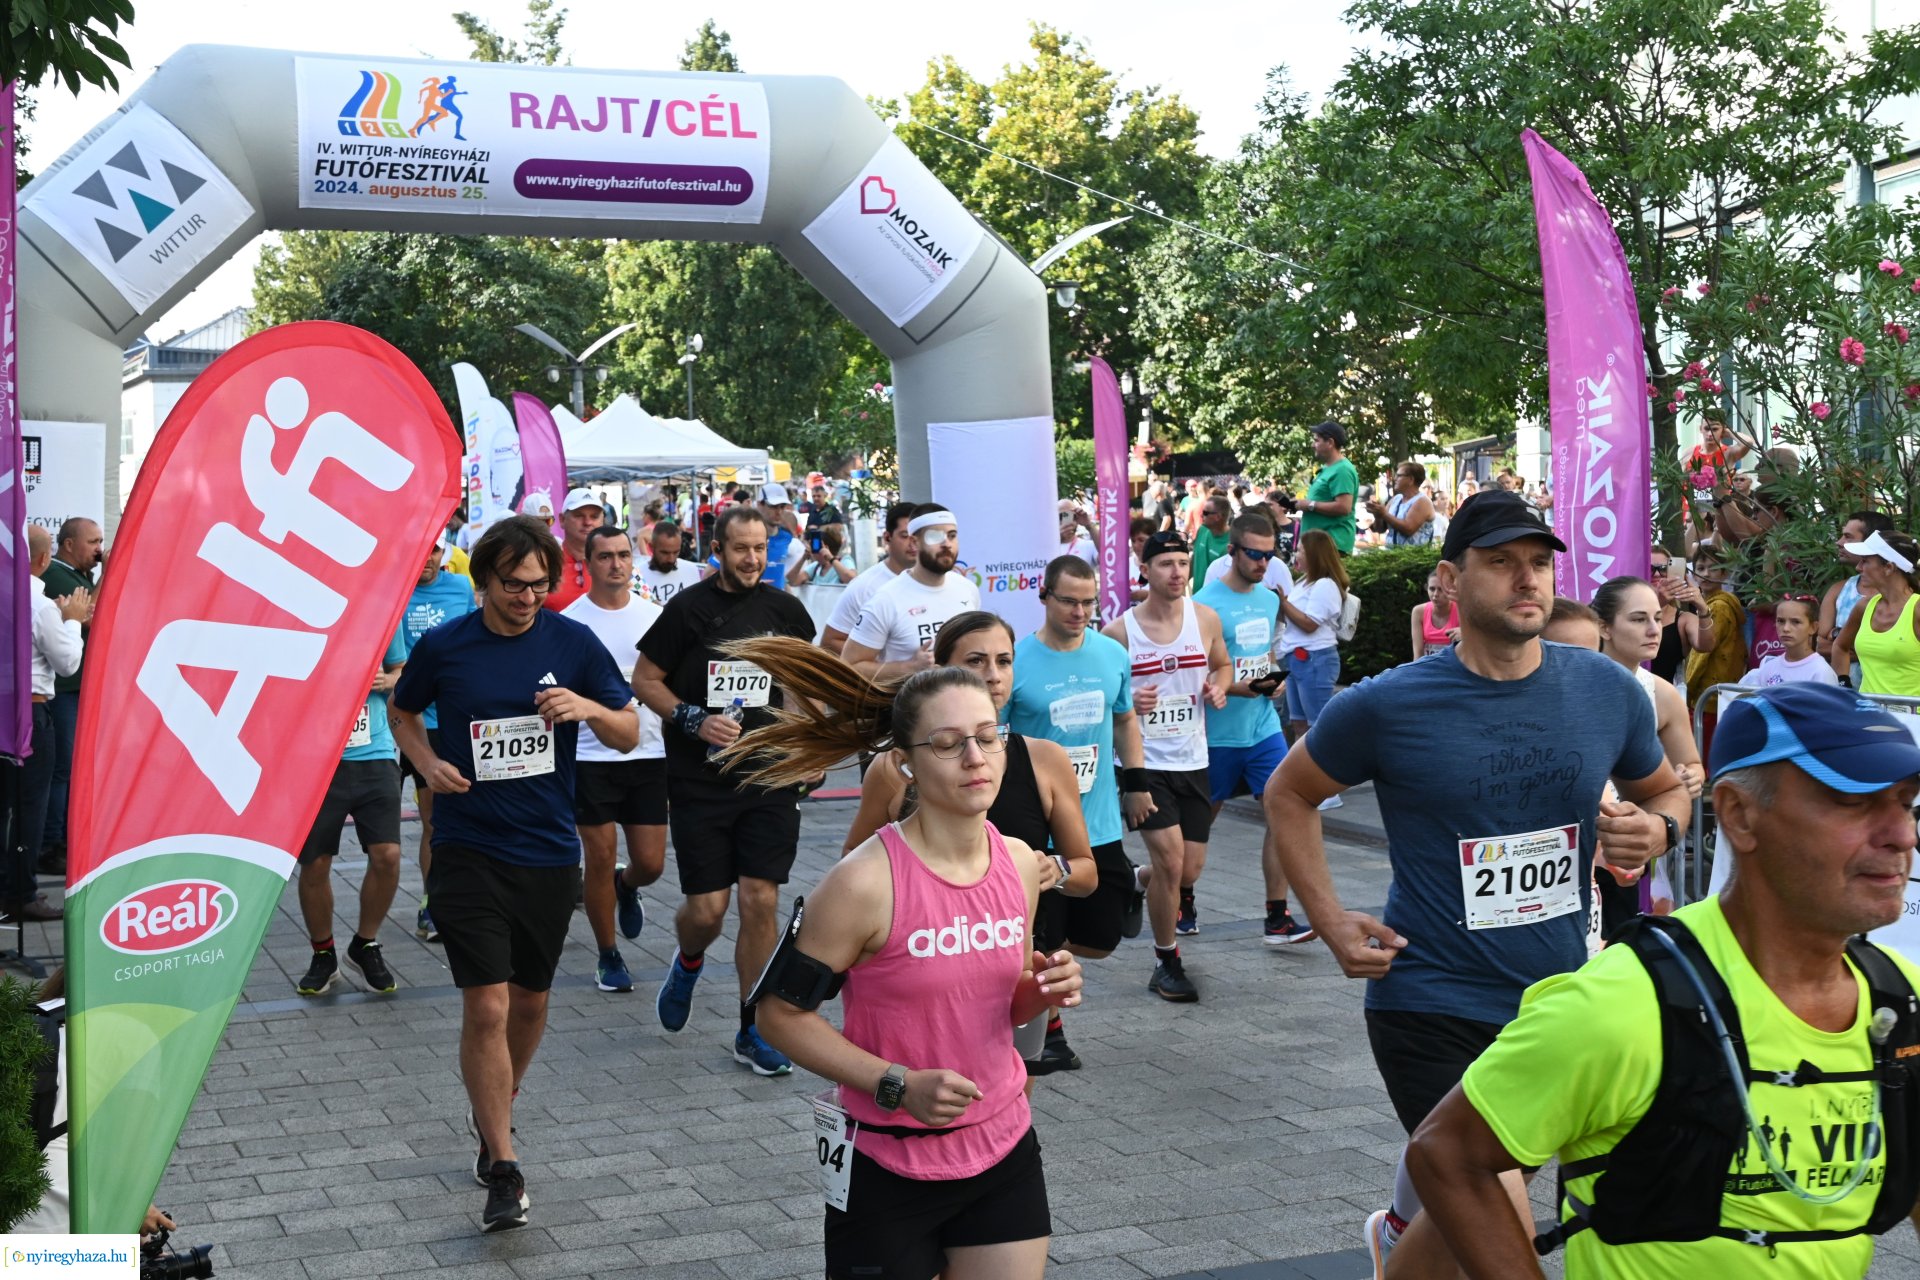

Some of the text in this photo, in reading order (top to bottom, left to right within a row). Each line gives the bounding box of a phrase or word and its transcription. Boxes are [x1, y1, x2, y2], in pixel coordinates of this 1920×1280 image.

[510, 92, 757, 139] RAJT/CÉL
[315, 157, 490, 184] FUTÓFESZTIVÁL
[317, 143, 490, 162] IV. WITTUR-NYÍREGYHÁZI
[314, 180, 487, 199] 2024. augusztus 25.
[526, 173, 742, 193] www.nyiregyhazifutofesztival.hu
[149, 213, 207, 264] WITTUR
[889, 207, 953, 270] MOZAIK
[135, 376, 415, 816] Alfi
[713, 675, 768, 691] 21070
[1148, 707, 1193, 725] 21151
[480, 734, 549, 760] 21039
[1475, 856, 1572, 897] 21002
[119, 887, 207, 942] Reál
[907, 913, 1025, 957] adidas
[114, 948, 225, 981] CSOPORT TAGJA
[815, 1136, 846, 1174] 04
[1810, 1121, 1883, 1163] VID
